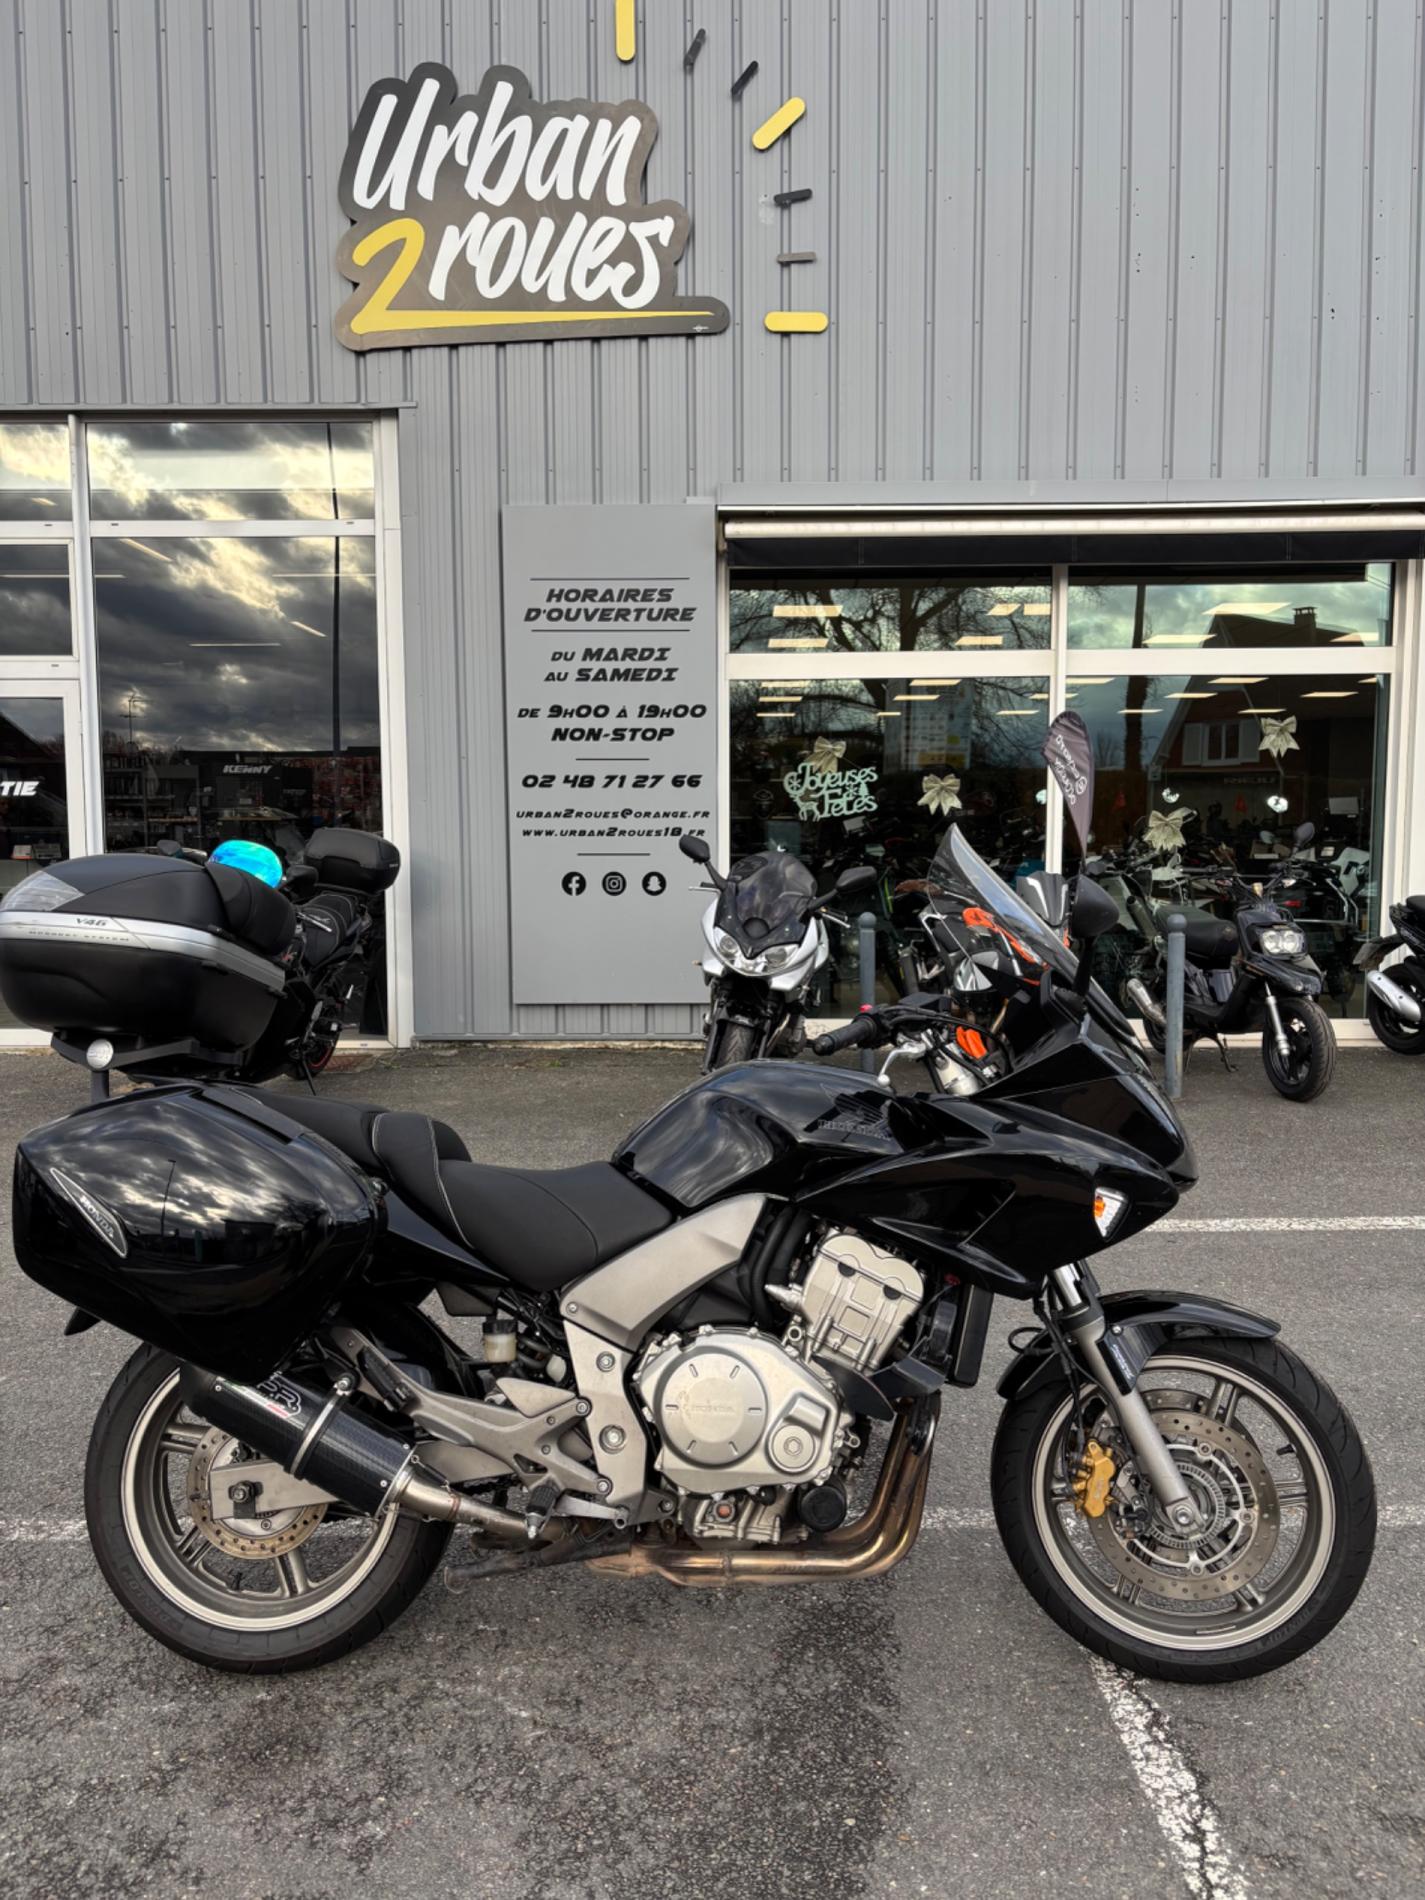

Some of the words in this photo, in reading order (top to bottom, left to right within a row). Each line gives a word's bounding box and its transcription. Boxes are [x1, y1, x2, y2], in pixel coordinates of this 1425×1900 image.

[353, 78, 641, 211] Urban
[428, 211, 675, 309] roues
[546, 588, 675, 603] HORAIRES
[524, 607, 697, 622] D'OUVERTURE
[551, 651, 576, 662] DU
[581, 647, 672, 662] MARDI
[544, 672, 569, 682] AU
[575, 667, 679, 682] SAMEDI
[517, 708, 541, 719] DE
[551, 728, 675, 742] NON-STOP
[521, 774, 556, 788] 02
[562, 774, 596, 788] 48
[602, 774, 627, 788] 71
[632, 774, 665, 788] 27
[671, 774, 703, 788] 66
[522, 827, 705, 837] WWW.URBAN2ROUES18FR
